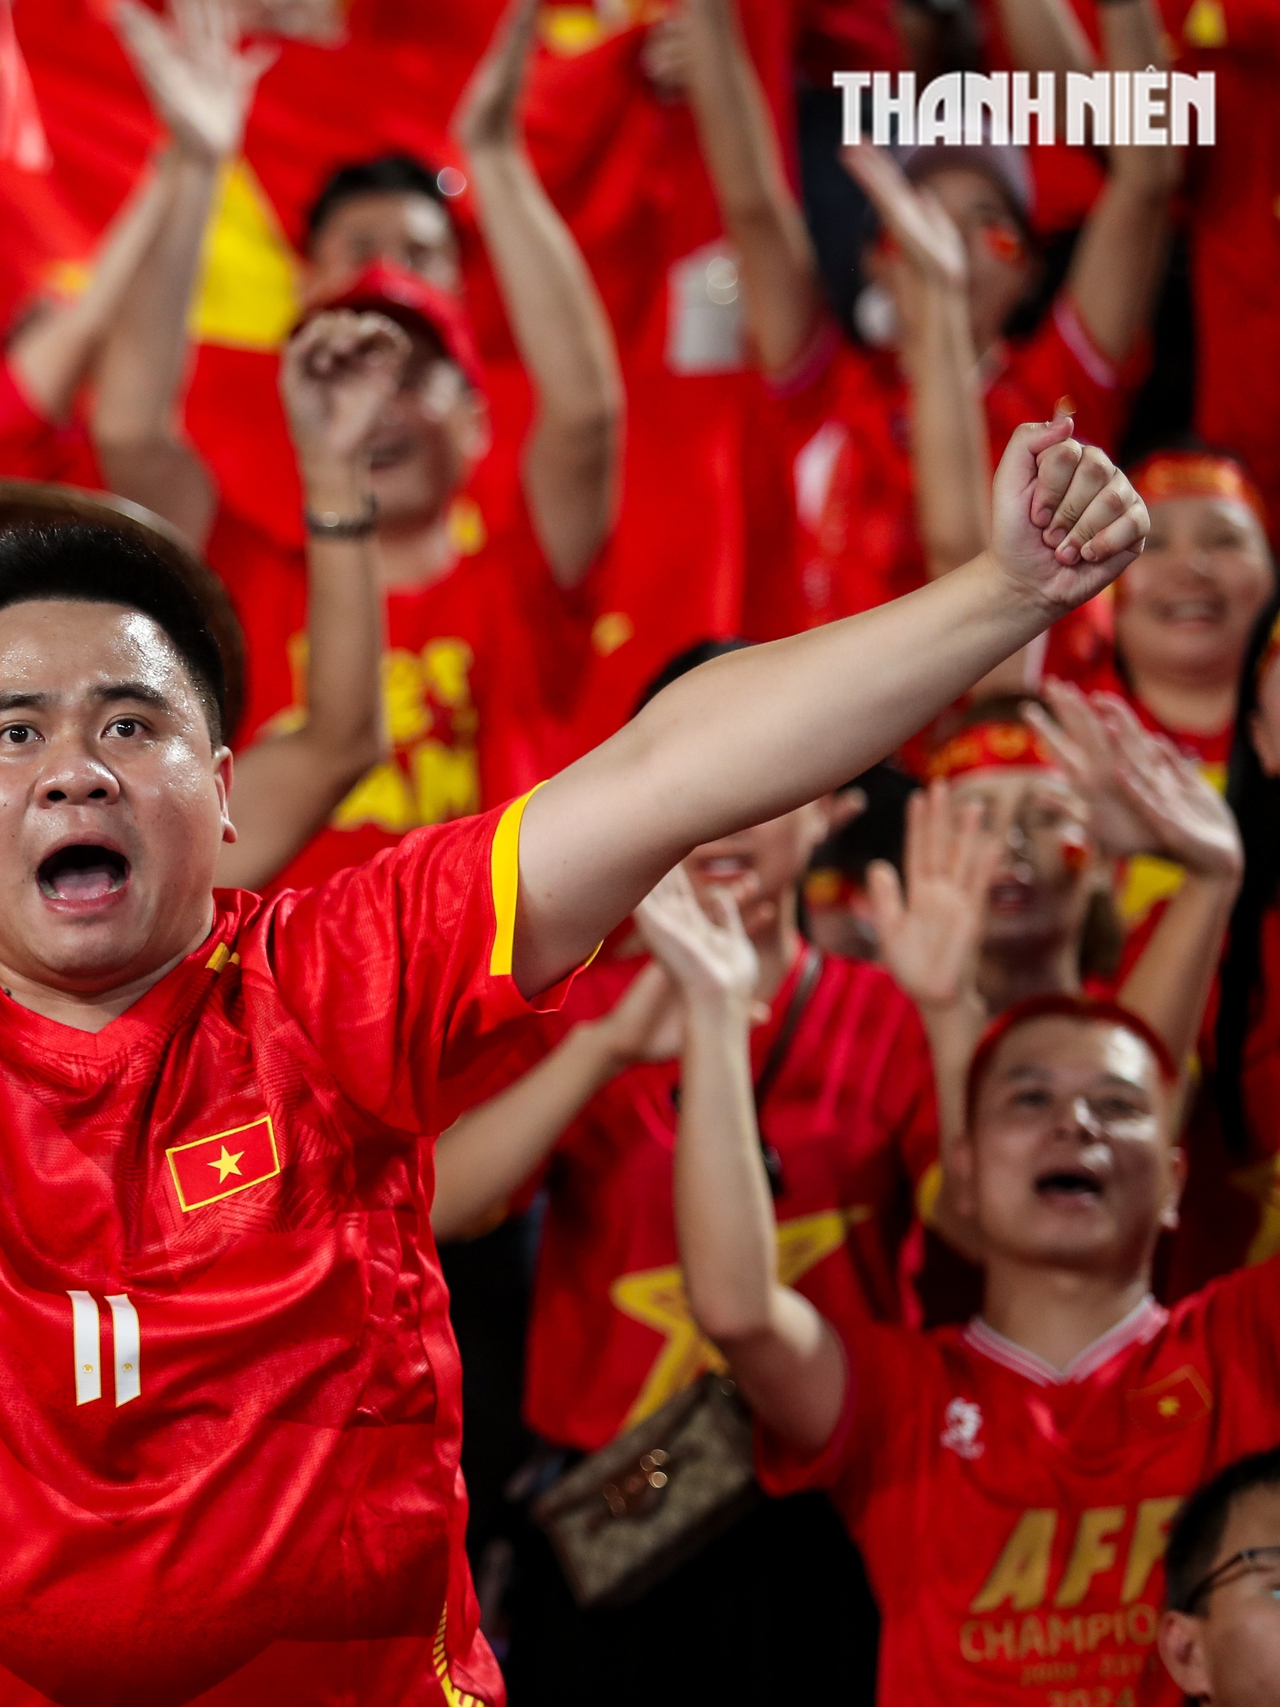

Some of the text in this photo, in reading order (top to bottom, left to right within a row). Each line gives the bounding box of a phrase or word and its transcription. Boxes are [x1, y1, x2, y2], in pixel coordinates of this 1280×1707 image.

[65, 1289, 142, 1409] 11
[970, 1495, 1188, 1614] AFF
[959, 1602, 1160, 1664] CHAMPIO
